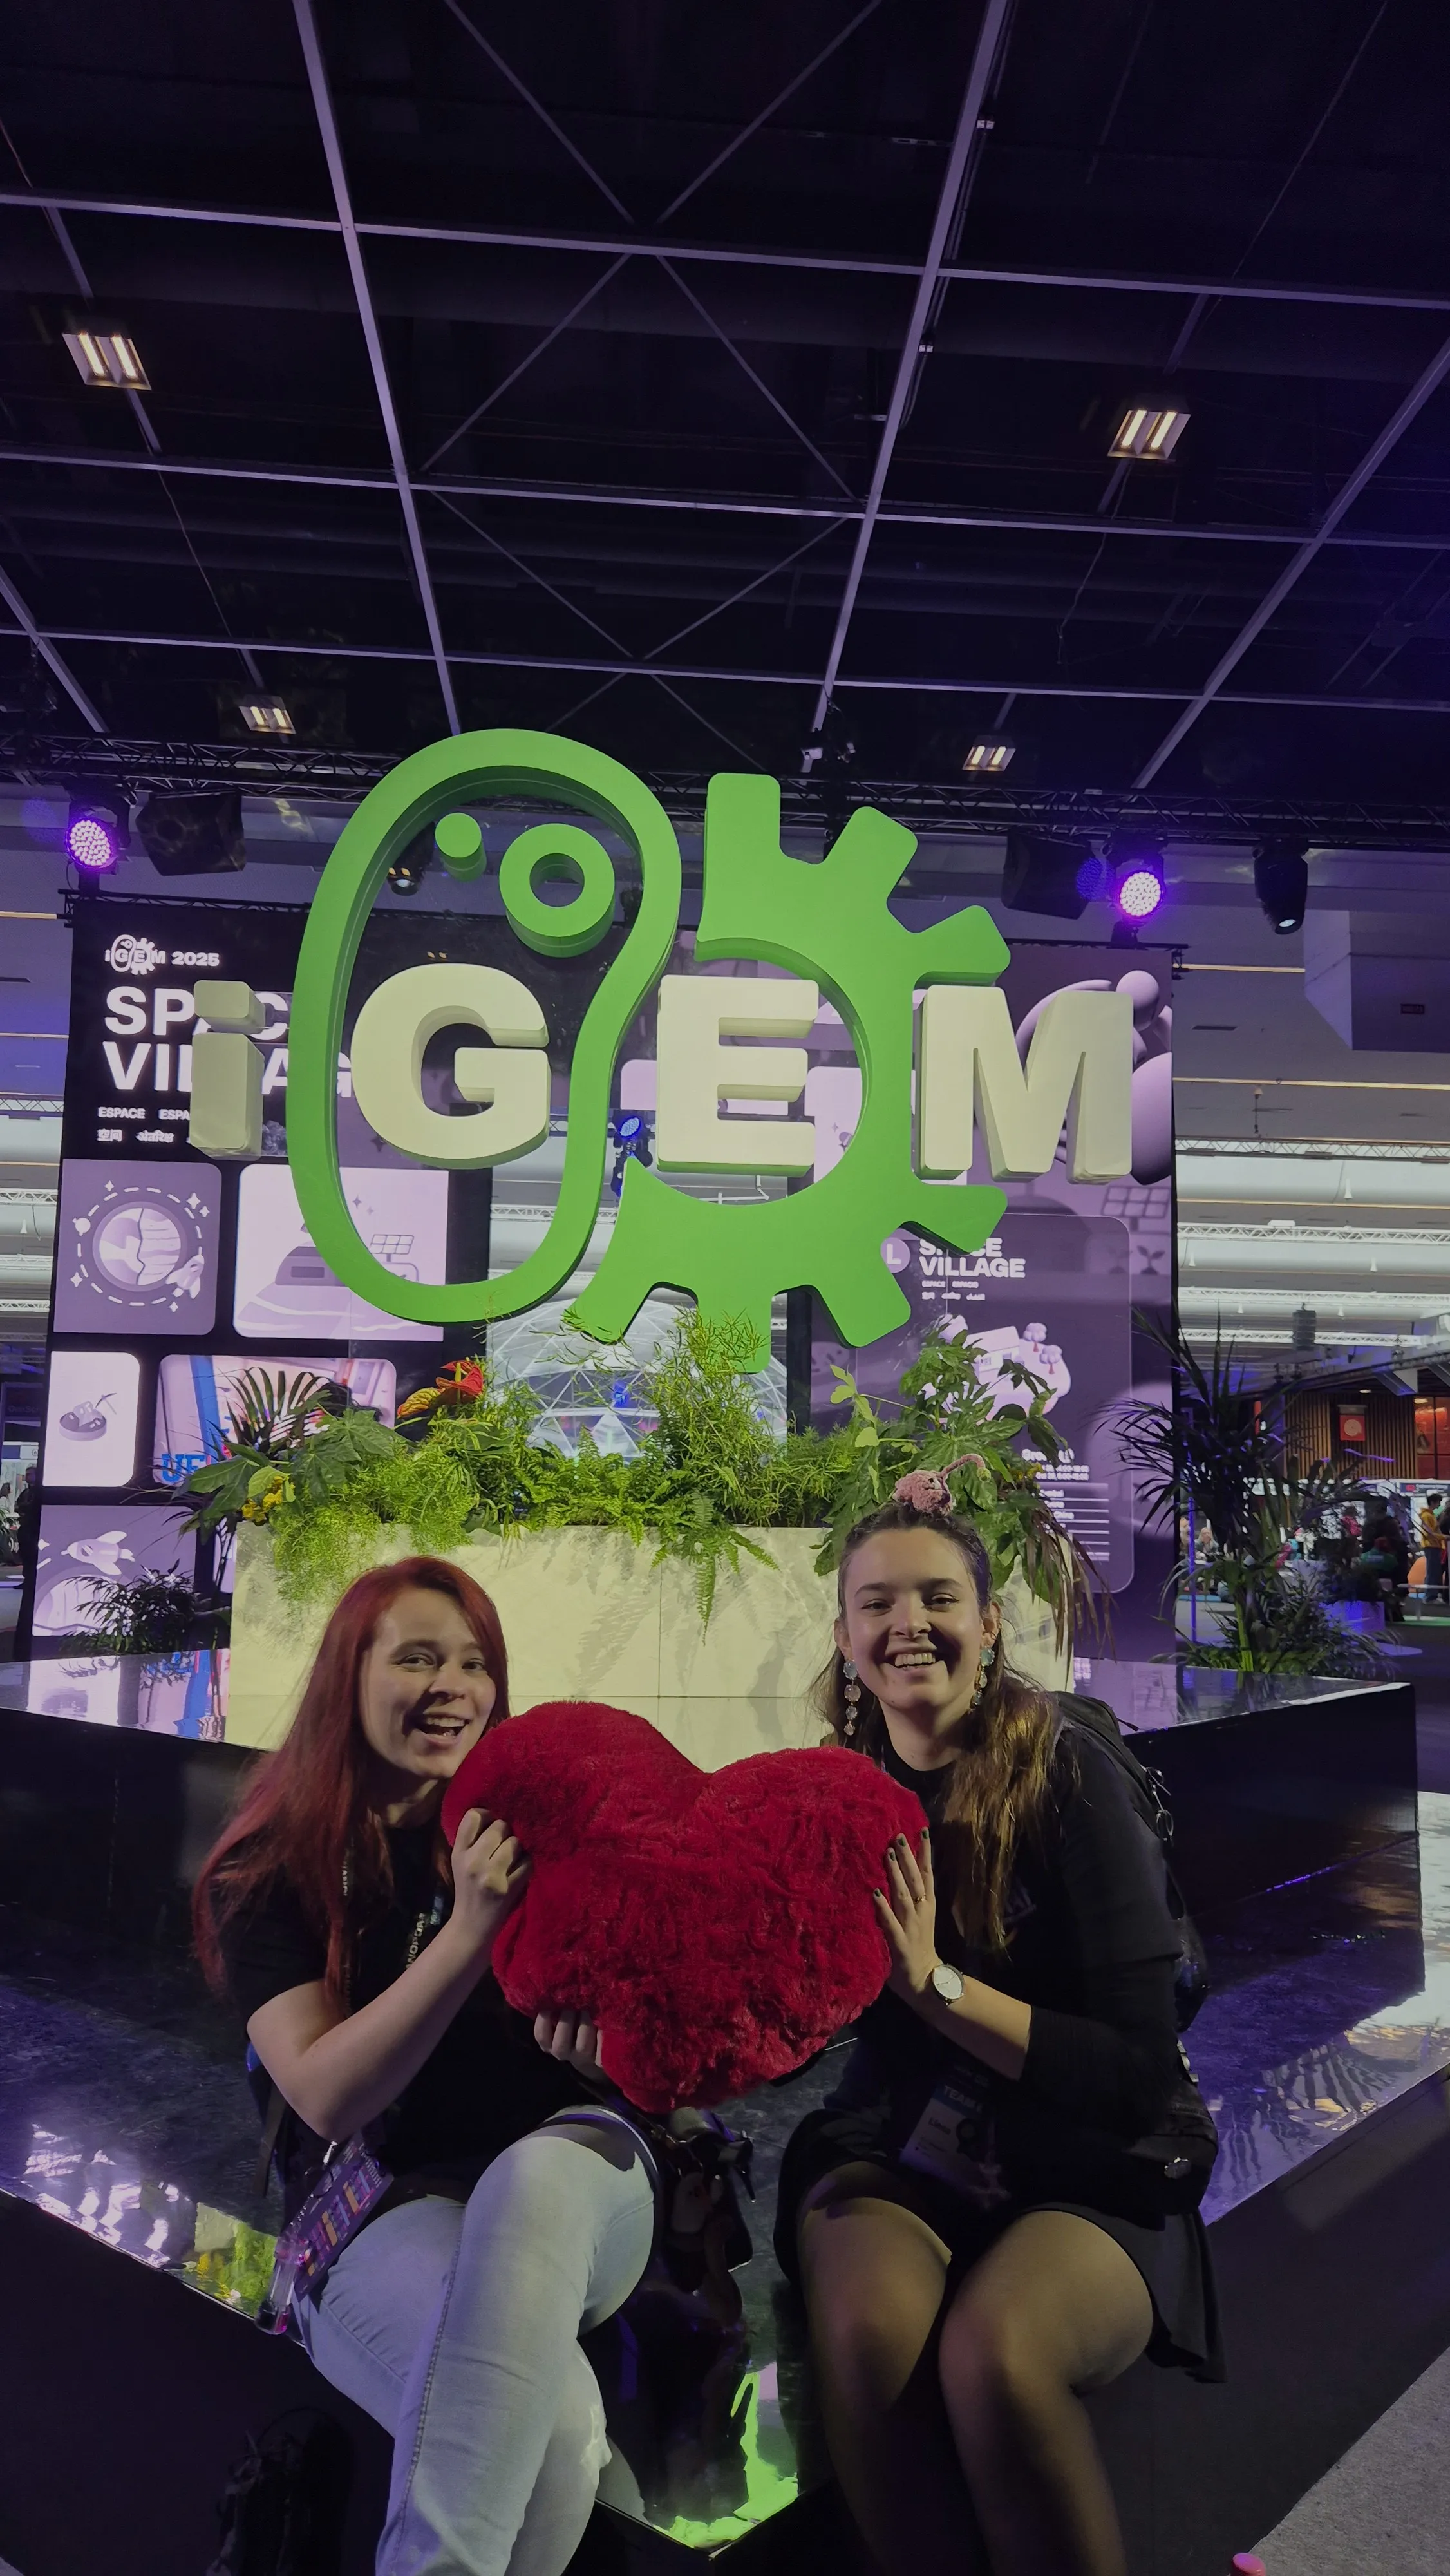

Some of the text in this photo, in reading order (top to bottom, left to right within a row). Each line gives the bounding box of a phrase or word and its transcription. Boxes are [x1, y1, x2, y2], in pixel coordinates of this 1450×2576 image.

[171, 951, 220, 967] 2025
[189, 962, 1133, 1184] iGEM
[98, 1106, 190, 1121] ESPACE ESPA
[887, 1244, 901, 1264] L
[919, 1256, 1026, 1278] VILLAGE
